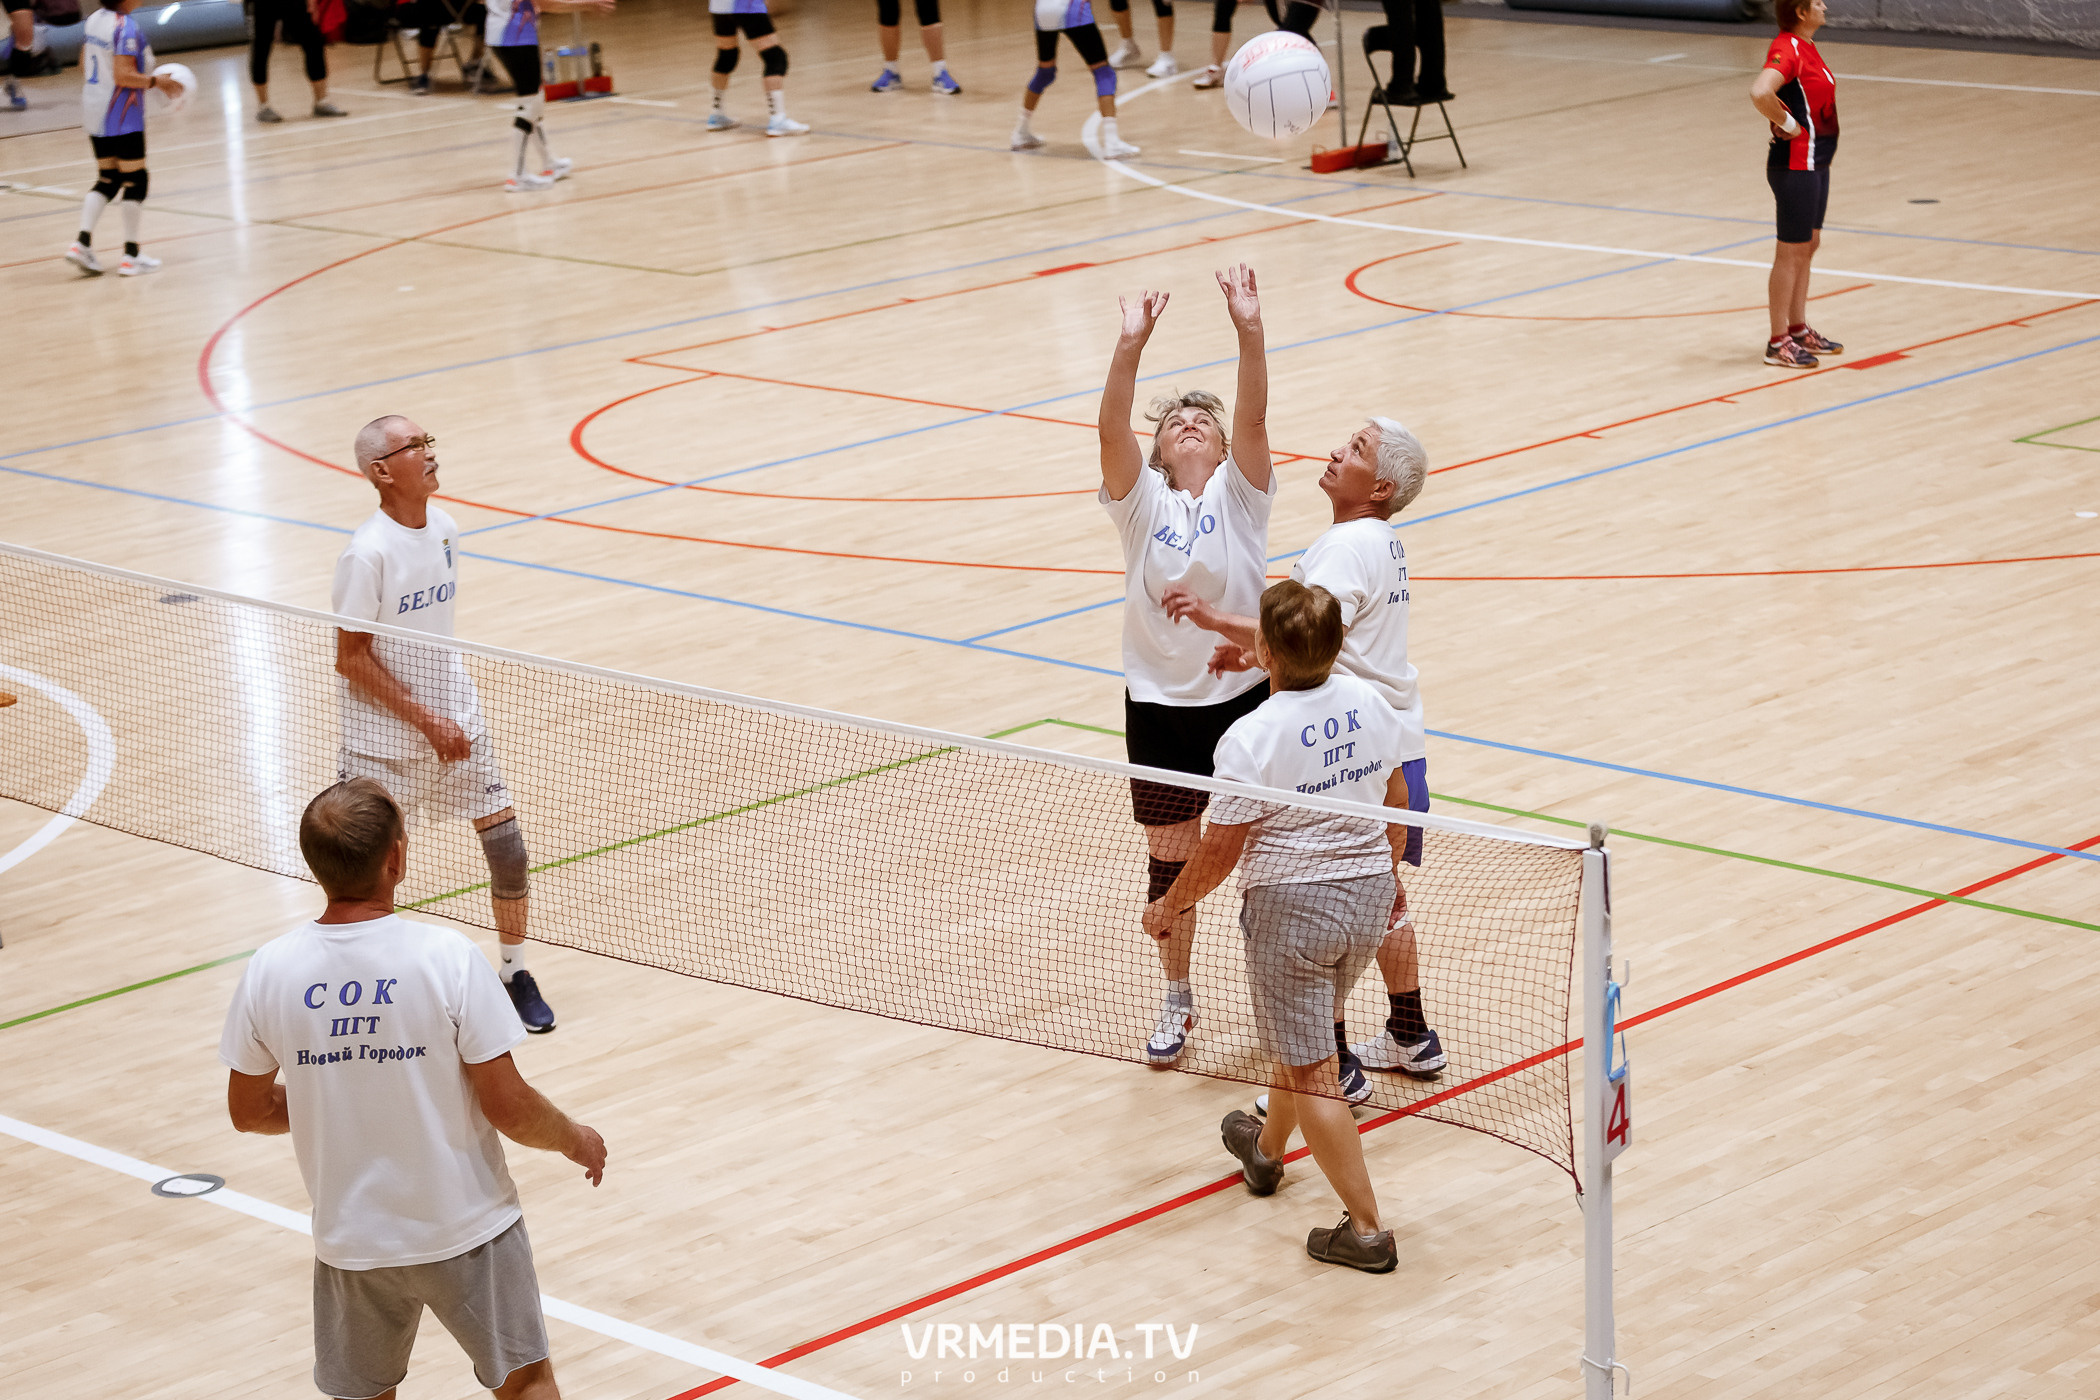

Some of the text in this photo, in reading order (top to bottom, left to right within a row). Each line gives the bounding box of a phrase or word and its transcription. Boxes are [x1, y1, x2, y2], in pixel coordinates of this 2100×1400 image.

[87, 55, 99, 84] 1
[1323, 741, 1356, 768] ПГТ
[1339, 759, 1382, 782] Городок
[329, 1016, 380, 1037] ПГТ
[296, 1045, 426, 1065] Новый Городок
[1606, 1082, 1630, 1147] 4
